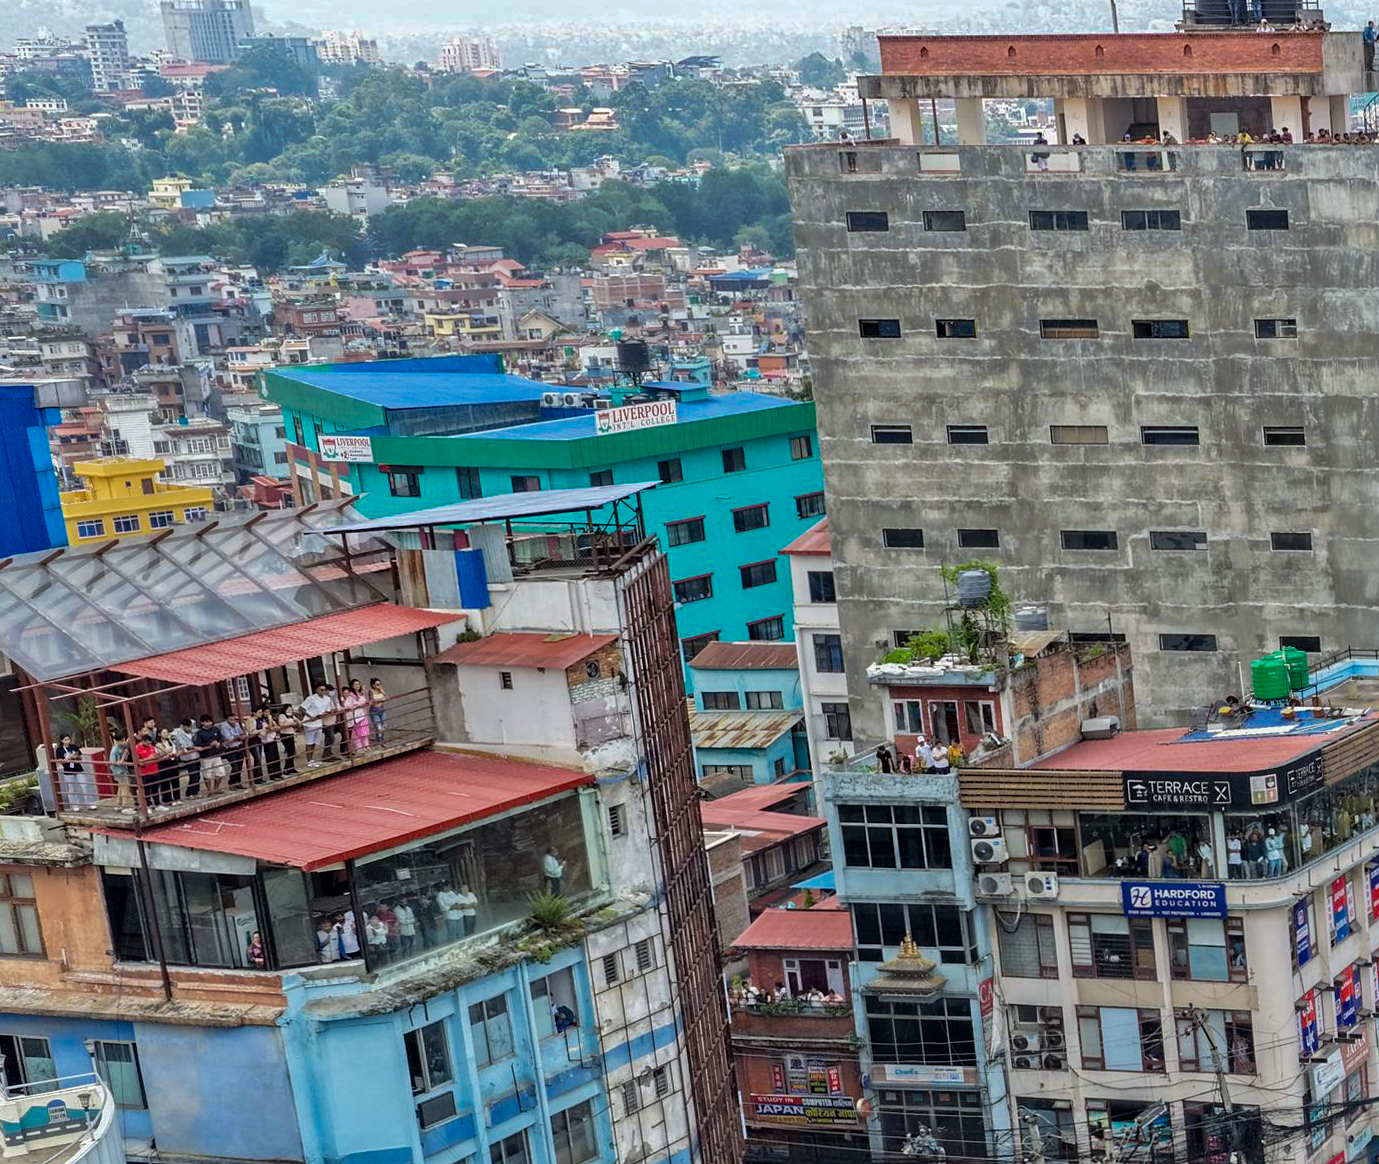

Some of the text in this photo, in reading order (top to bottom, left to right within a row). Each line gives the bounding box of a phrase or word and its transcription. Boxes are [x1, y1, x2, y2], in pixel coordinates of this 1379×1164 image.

[612, 402, 675, 423] LIVERPOOL
[641, 415, 675, 426] COLLEGE
[336, 438, 370, 446] LIVERPOOL
[1149, 780, 1210, 795] TERRACE
[1179, 795, 1209, 803] RESTRO
[1154, 889, 1216, 900] HARDFORD
[1346, 1034, 1367, 1058] JAPAN
[757, 1105, 804, 1114] JAPAN
